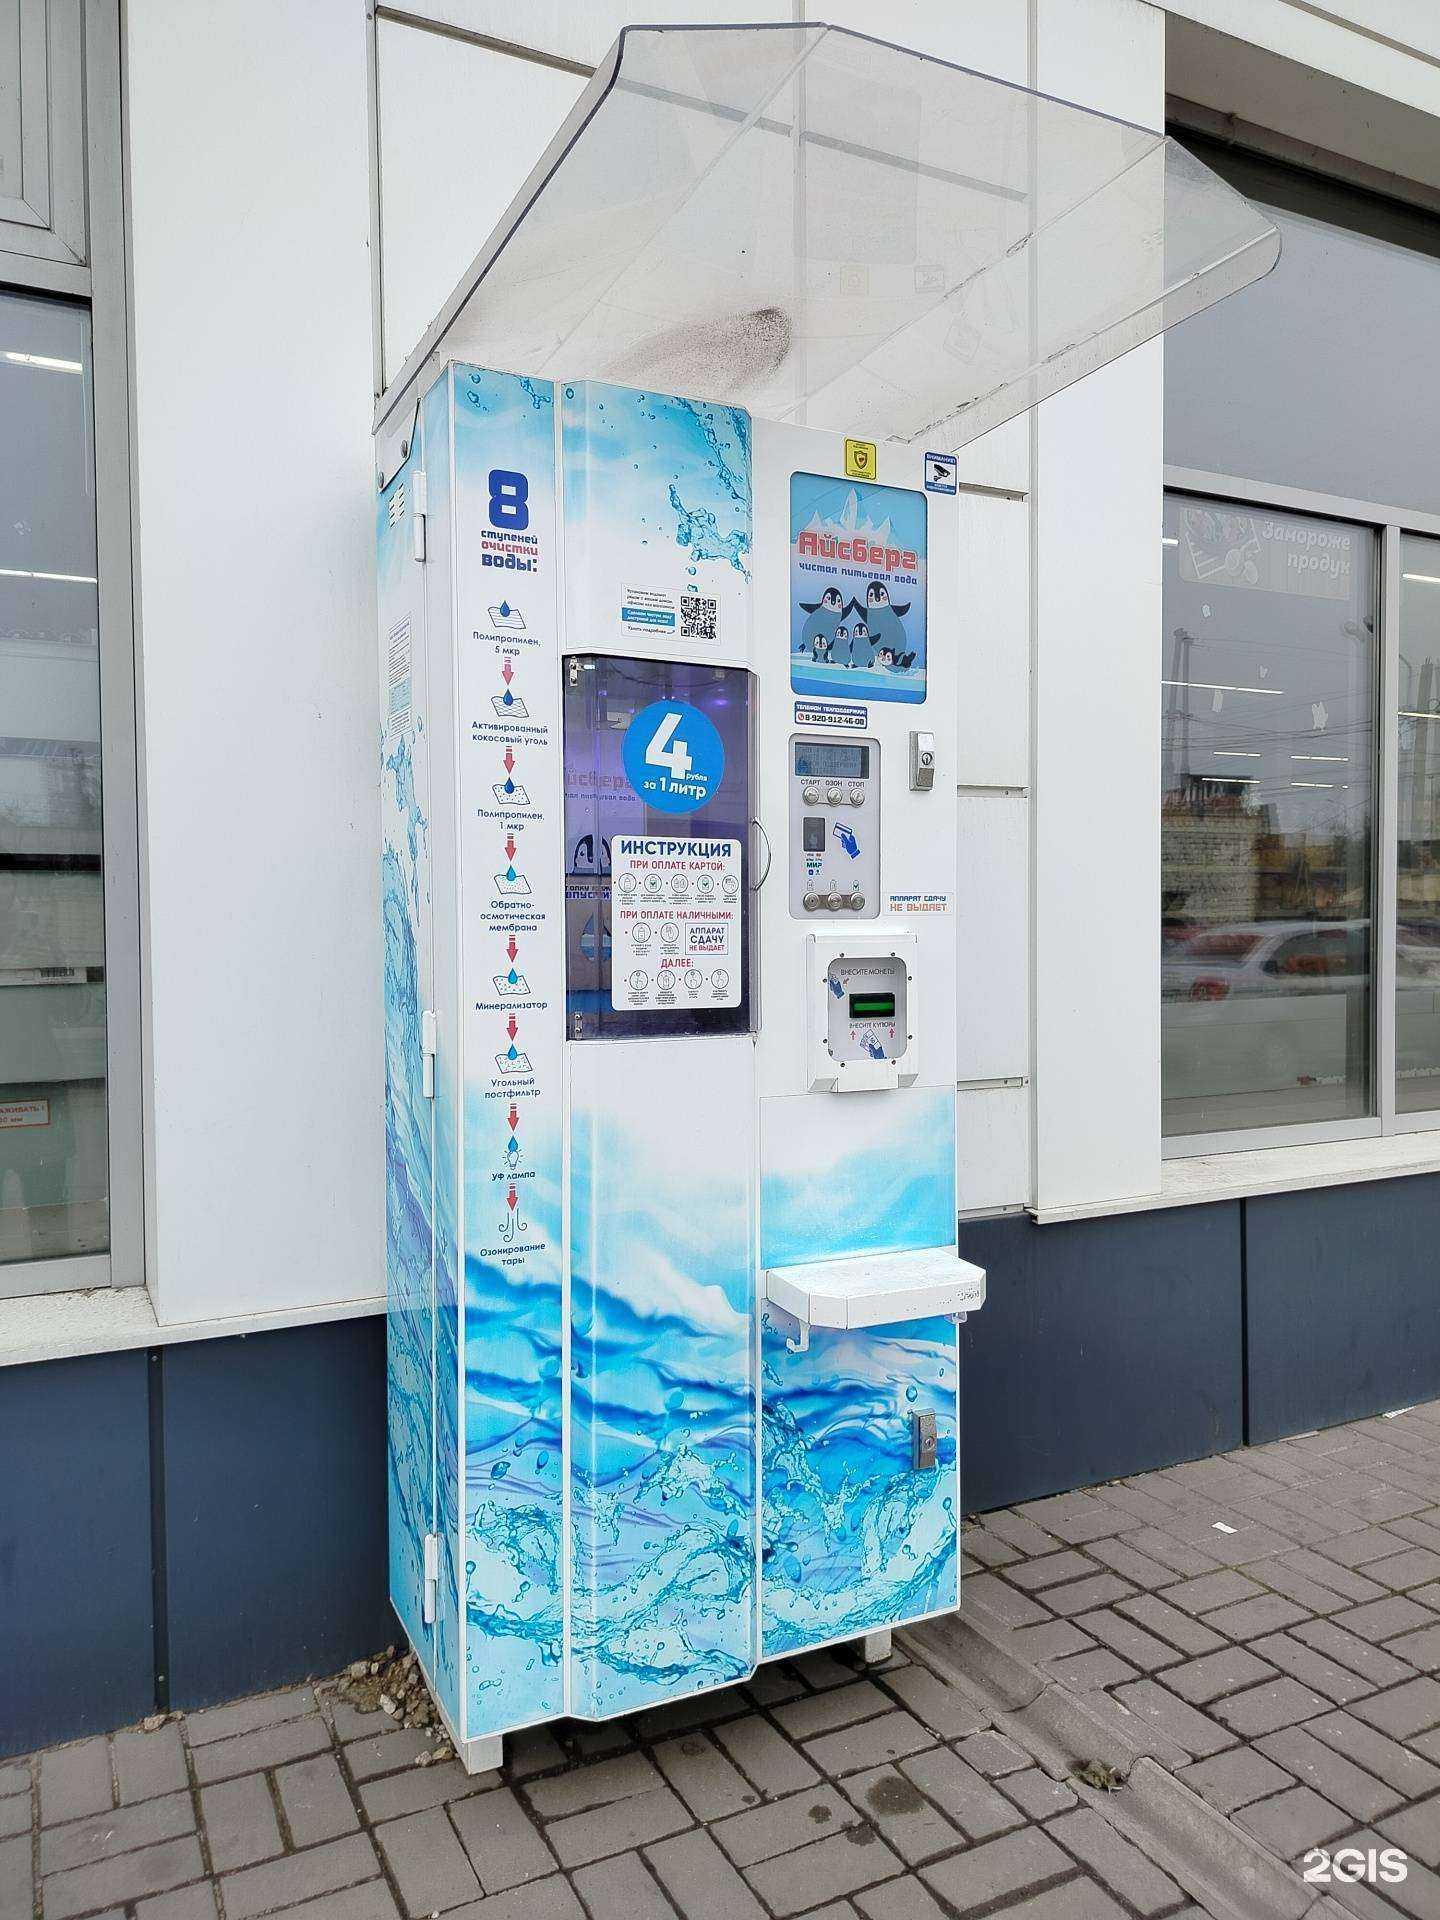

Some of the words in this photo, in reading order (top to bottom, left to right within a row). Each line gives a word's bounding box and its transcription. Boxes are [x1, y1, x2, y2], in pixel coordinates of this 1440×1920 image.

[488, 469, 529, 531] 8
[481, 529, 538, 545] ступеней
[481, 540, 538, 556] очистки
[799, 531, 918, 572] Айсберг
[482, 553, 538, 572] воды:
[799, 562, 838, 575] чистая
[842, 568, 891, 582] питьевая
[895, 575, 918, 585] вода
[473, 631, 541, 647] Полипропилен,
[495, 646, 500, 654] 5
[502, 647, 520, 656] мкр
[472, 720, 548, 734] Активированный
[472, 733, 522, 744] кокосовый
[525, 737, 548, 746] уголь
[645, 712, 692, 780] 4
[685, 772, 708, 782] рубля
[644, 780, 656, 790] за
[659, 777, 666, 792] 1
[669, 781, 707, 800] литр
[477, 809, 545, 821] Полипропилен,
[500, 822, 504, 830] 1
[507, 823, 525, 831] мкр
[621, 840, 731, 858] ИНСТРУКЦИЯ
[630, 860, 648, 869] ПРИ
[651, 860, 687, 870] ОПЛАТЕ
[689, 860, 726, 871] КАРТОЙ:
[490, 900, 535, 911] Обратно-
[890, 903, 903, 912] НЕ
[907, 903, 947, 912] ВЫДАЕТ
[480, 913, 546, 921] осмотическая
[620, 910, 638, 919] ПРИ
[640, 910, 674, 919] ОПЛАТЕ
[676, 911, 734, 920] НАЛИЧНЫМИ:
[488, 923, 538, 932] мембрана
[690, 935, 724, 945] СДАЧУ
[661, 959, 694, 969] ДАЛЕЕ:
[475, 1002, 548, 1011] Минерализатор
[490, 1077, 535, 1088] Угольный
[484, 1088, 541, 1099] постфильтр
[507, 1171, 536, 1180] лампа
[480, 1243, 546, 1257] Озонирование
[502, 1256, 525, 1266] тары
